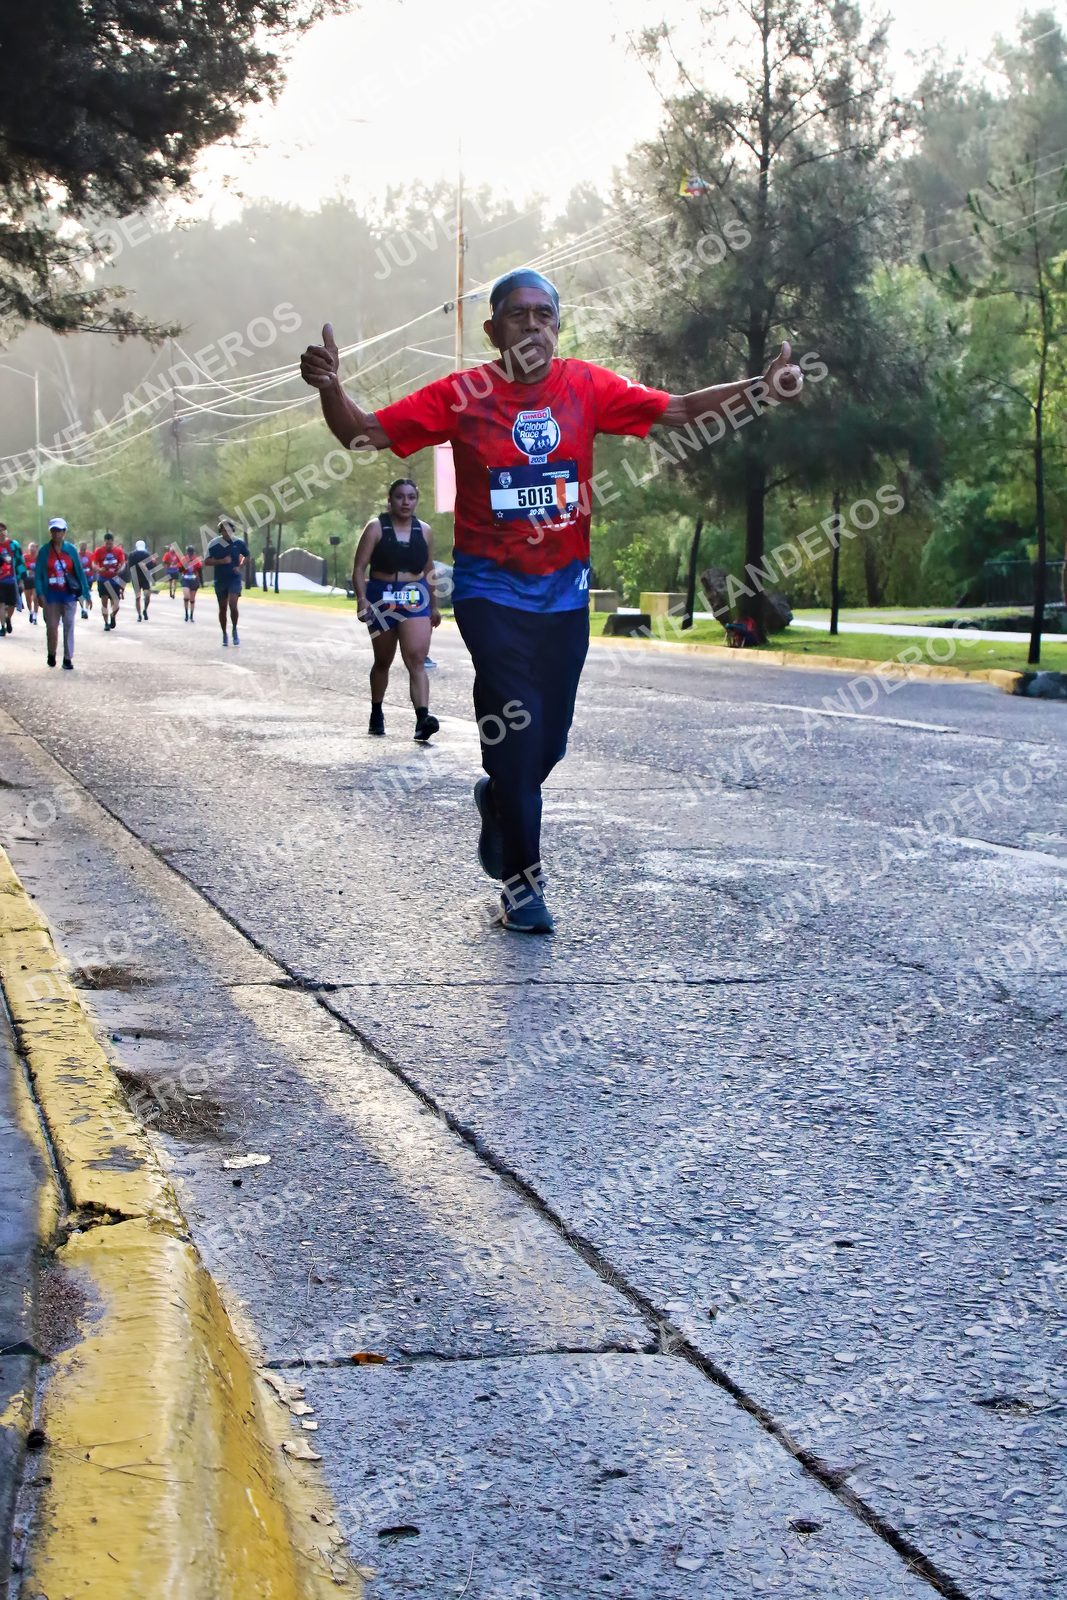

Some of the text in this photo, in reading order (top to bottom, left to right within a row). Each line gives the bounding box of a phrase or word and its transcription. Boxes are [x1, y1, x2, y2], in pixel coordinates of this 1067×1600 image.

[522, 412, 547, 420] BIMBO
[523, 421, 548, 432] Global
[519, 430, 540, 438] Race
[530, 456, 546, 464] 2026
[517, 486, 553, 507] 5013
